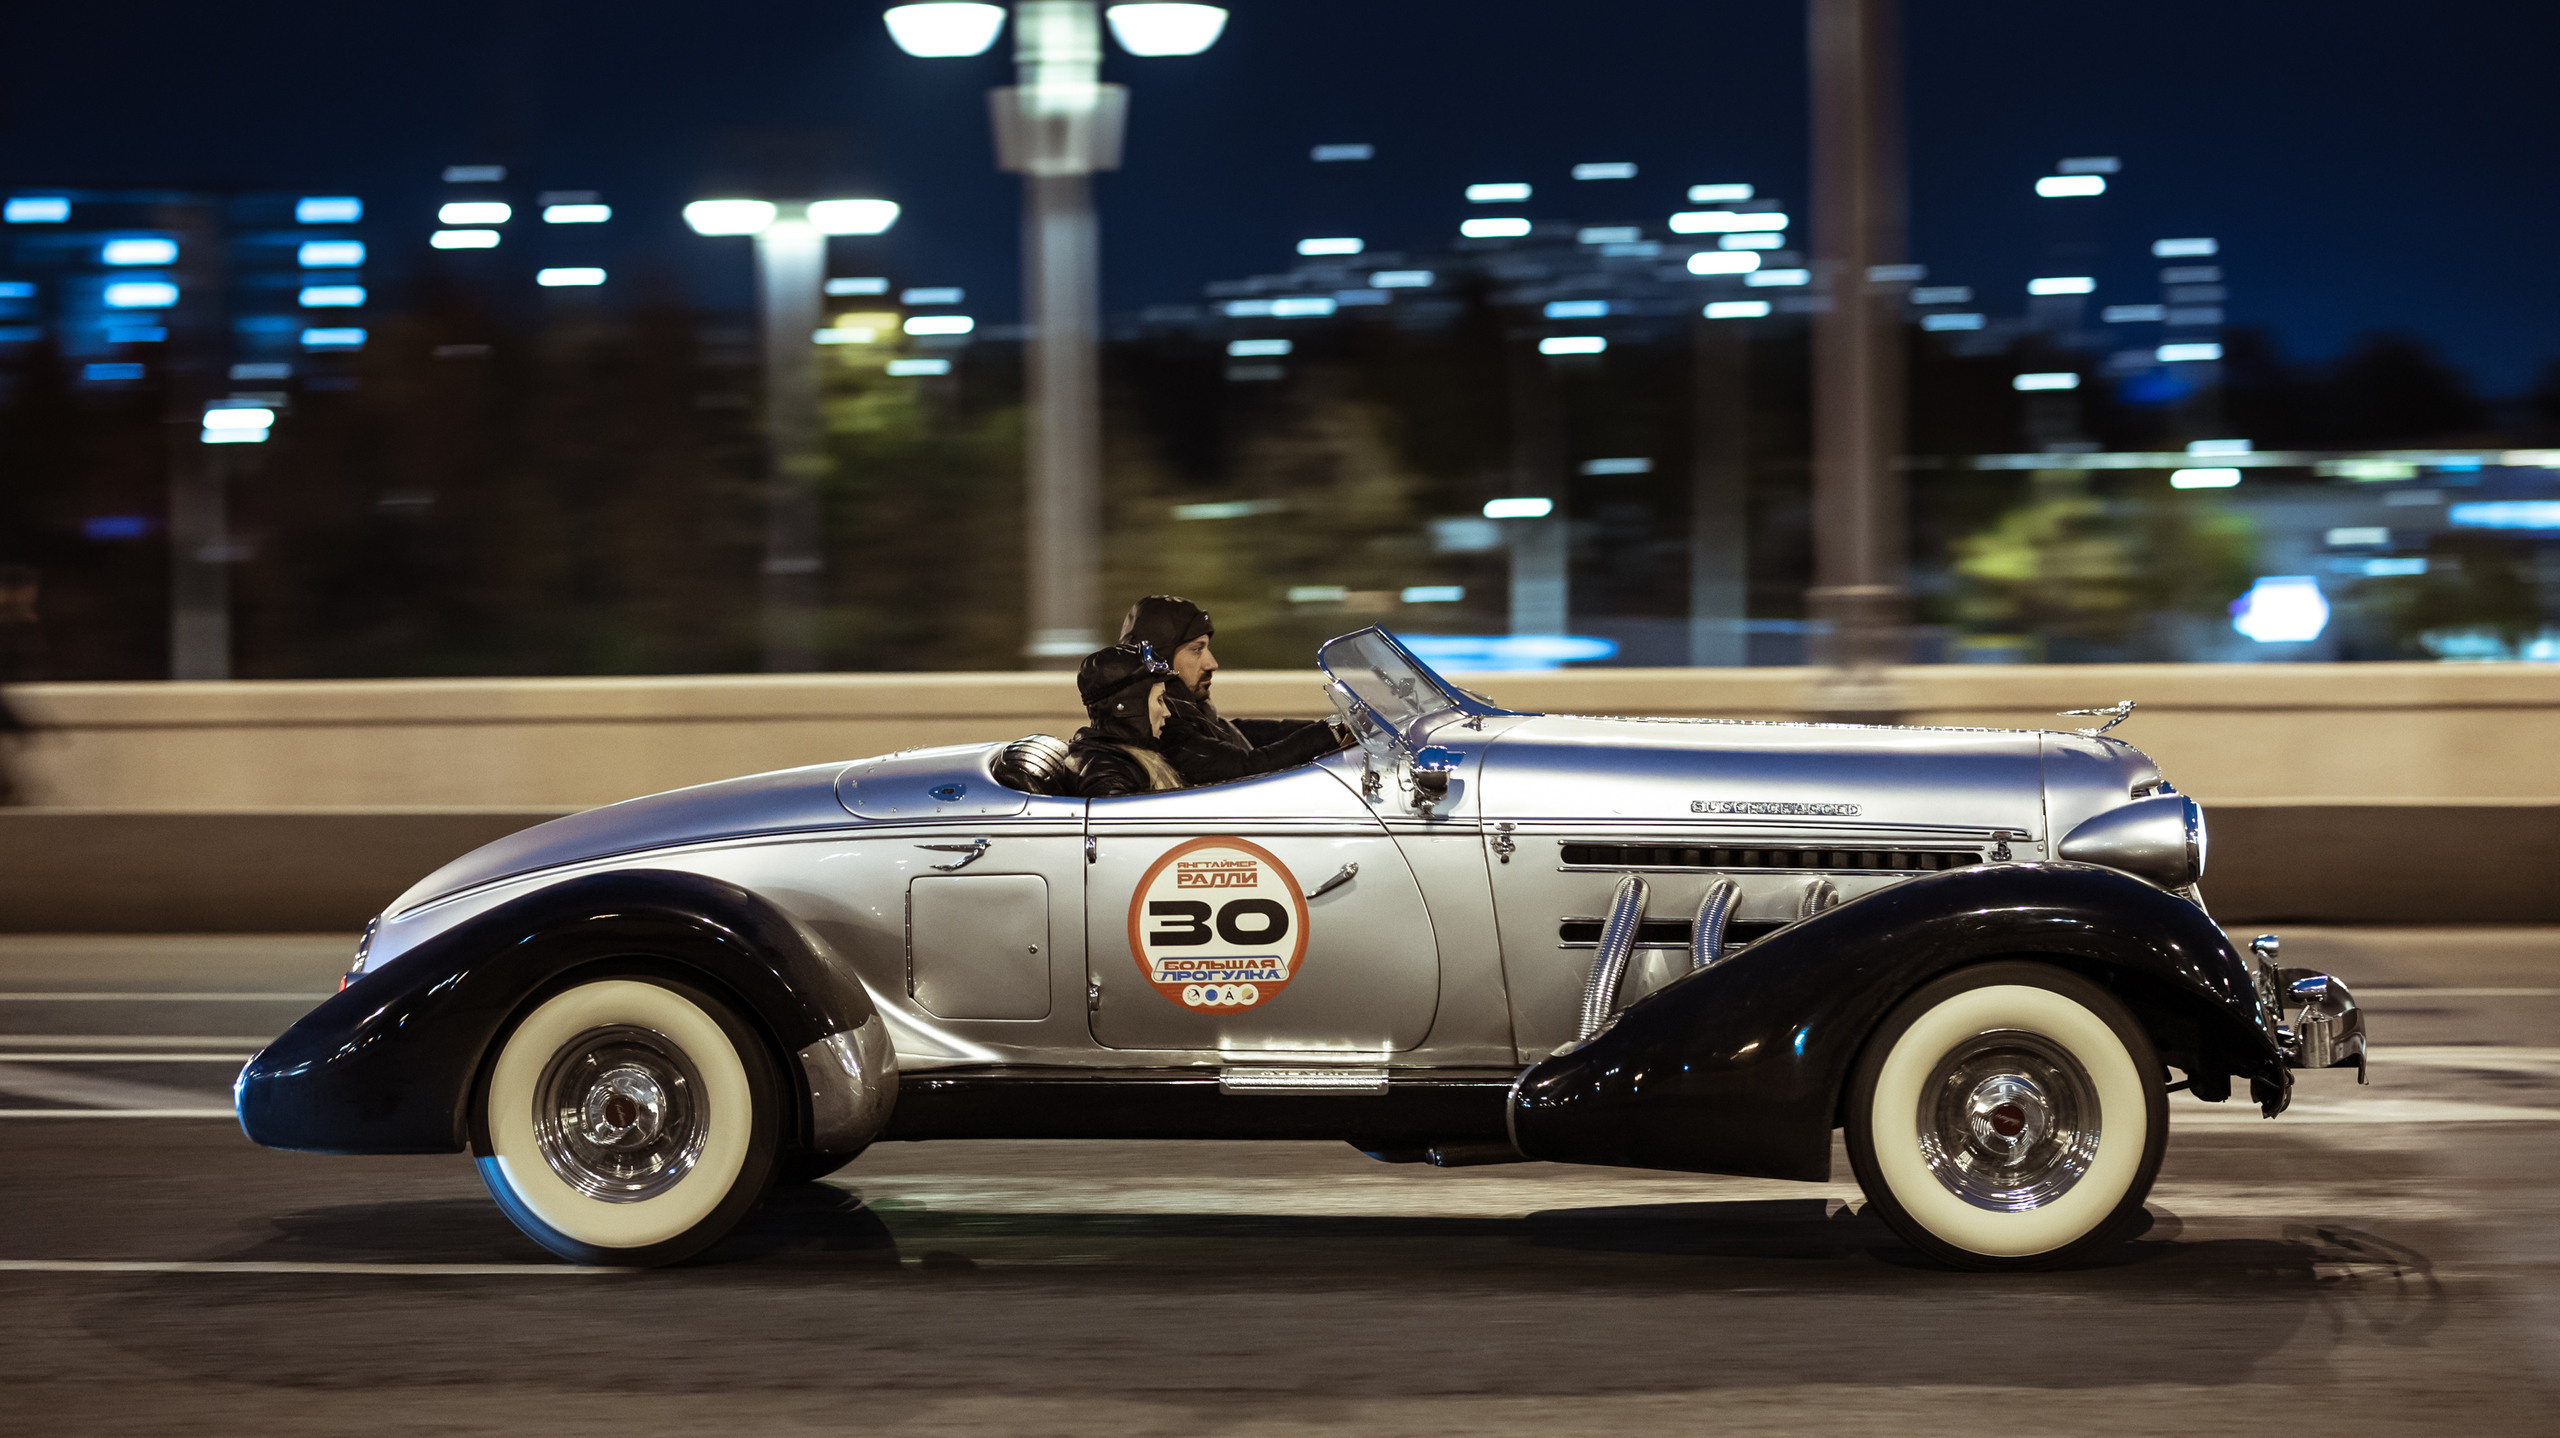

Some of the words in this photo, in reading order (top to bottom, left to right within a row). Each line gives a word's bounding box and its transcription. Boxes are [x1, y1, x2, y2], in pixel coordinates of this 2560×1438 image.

[1177, 860, 1257, 868] ЯНГТАЙМЕР
[1177, 873, 1258, 886] РАЛЛИ
[1149, 899, 1289, 946] 30
[1164, 960, 1276, 970] БОЛЬШАЯ
[1161, 969, 1281, 981] ПРОГУЛКА
